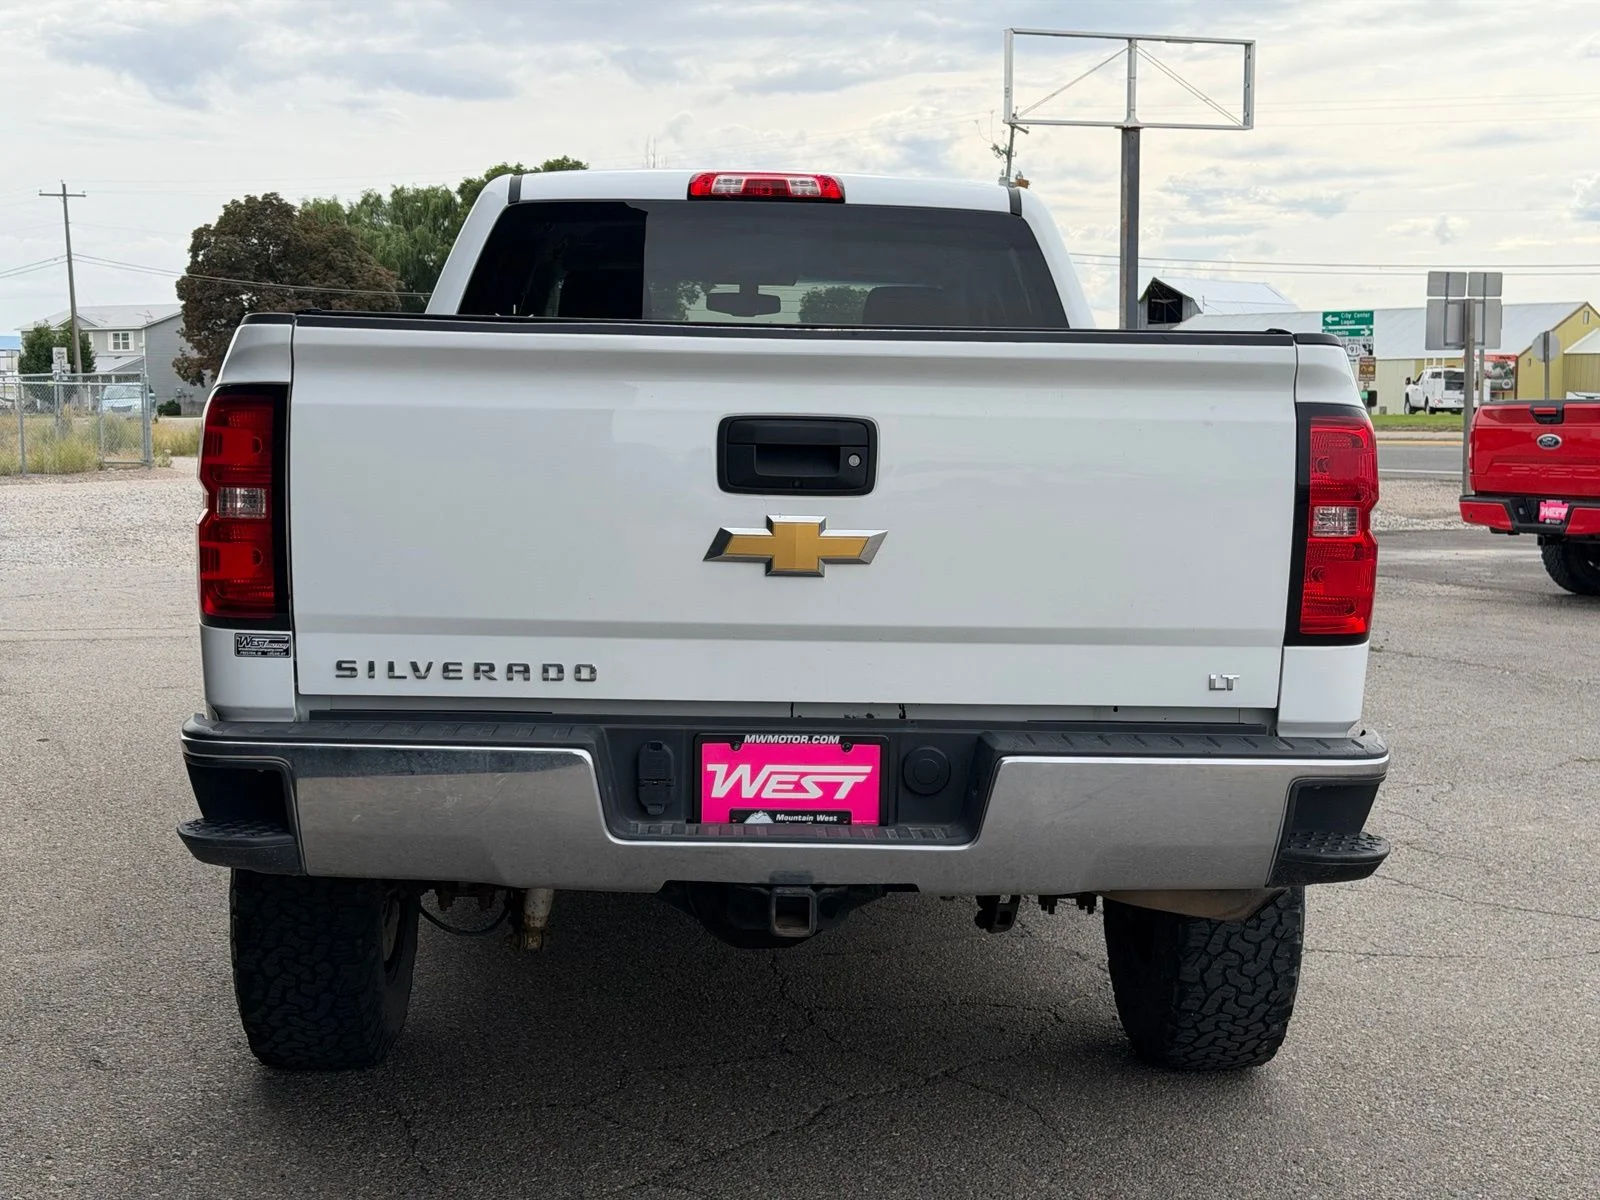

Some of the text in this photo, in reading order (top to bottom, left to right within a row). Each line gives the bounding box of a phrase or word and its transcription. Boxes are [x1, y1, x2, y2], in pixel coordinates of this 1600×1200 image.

[335, 660, 598, 682] SILVERADO
[1208, 674, 1241, 691] LT
[744, 734, 840, 745] MWMOTOR.COM
[706, 763, 873, 800] WEST
[776, 813, 838, 822] Mountain West
